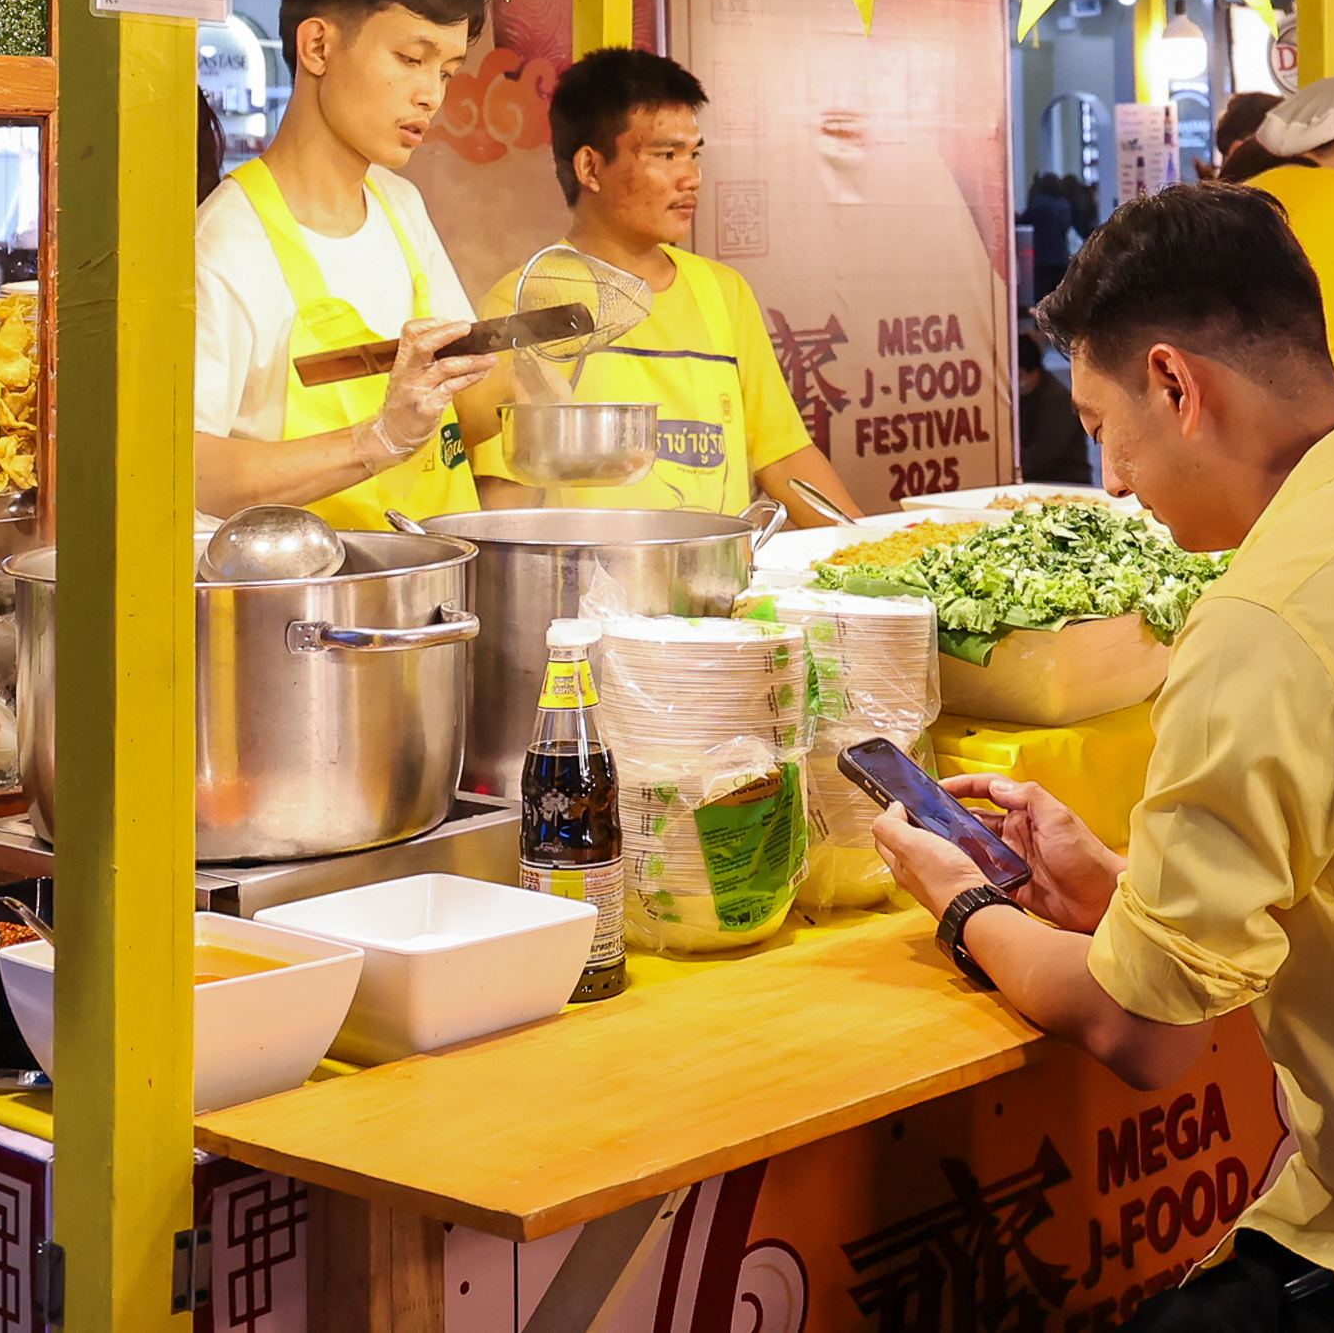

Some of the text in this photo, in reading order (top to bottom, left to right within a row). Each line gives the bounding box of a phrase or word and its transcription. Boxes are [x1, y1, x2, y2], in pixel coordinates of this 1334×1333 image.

[878, 314, 964, 357] MEGA
[856, 405, 990, 457] FESTIVAL
[889, 457, 960, 502] 2025
[1098, 1082, 1231, 1195] MEGA
[1081, 1157, 1248, 1290] J-FOOD
